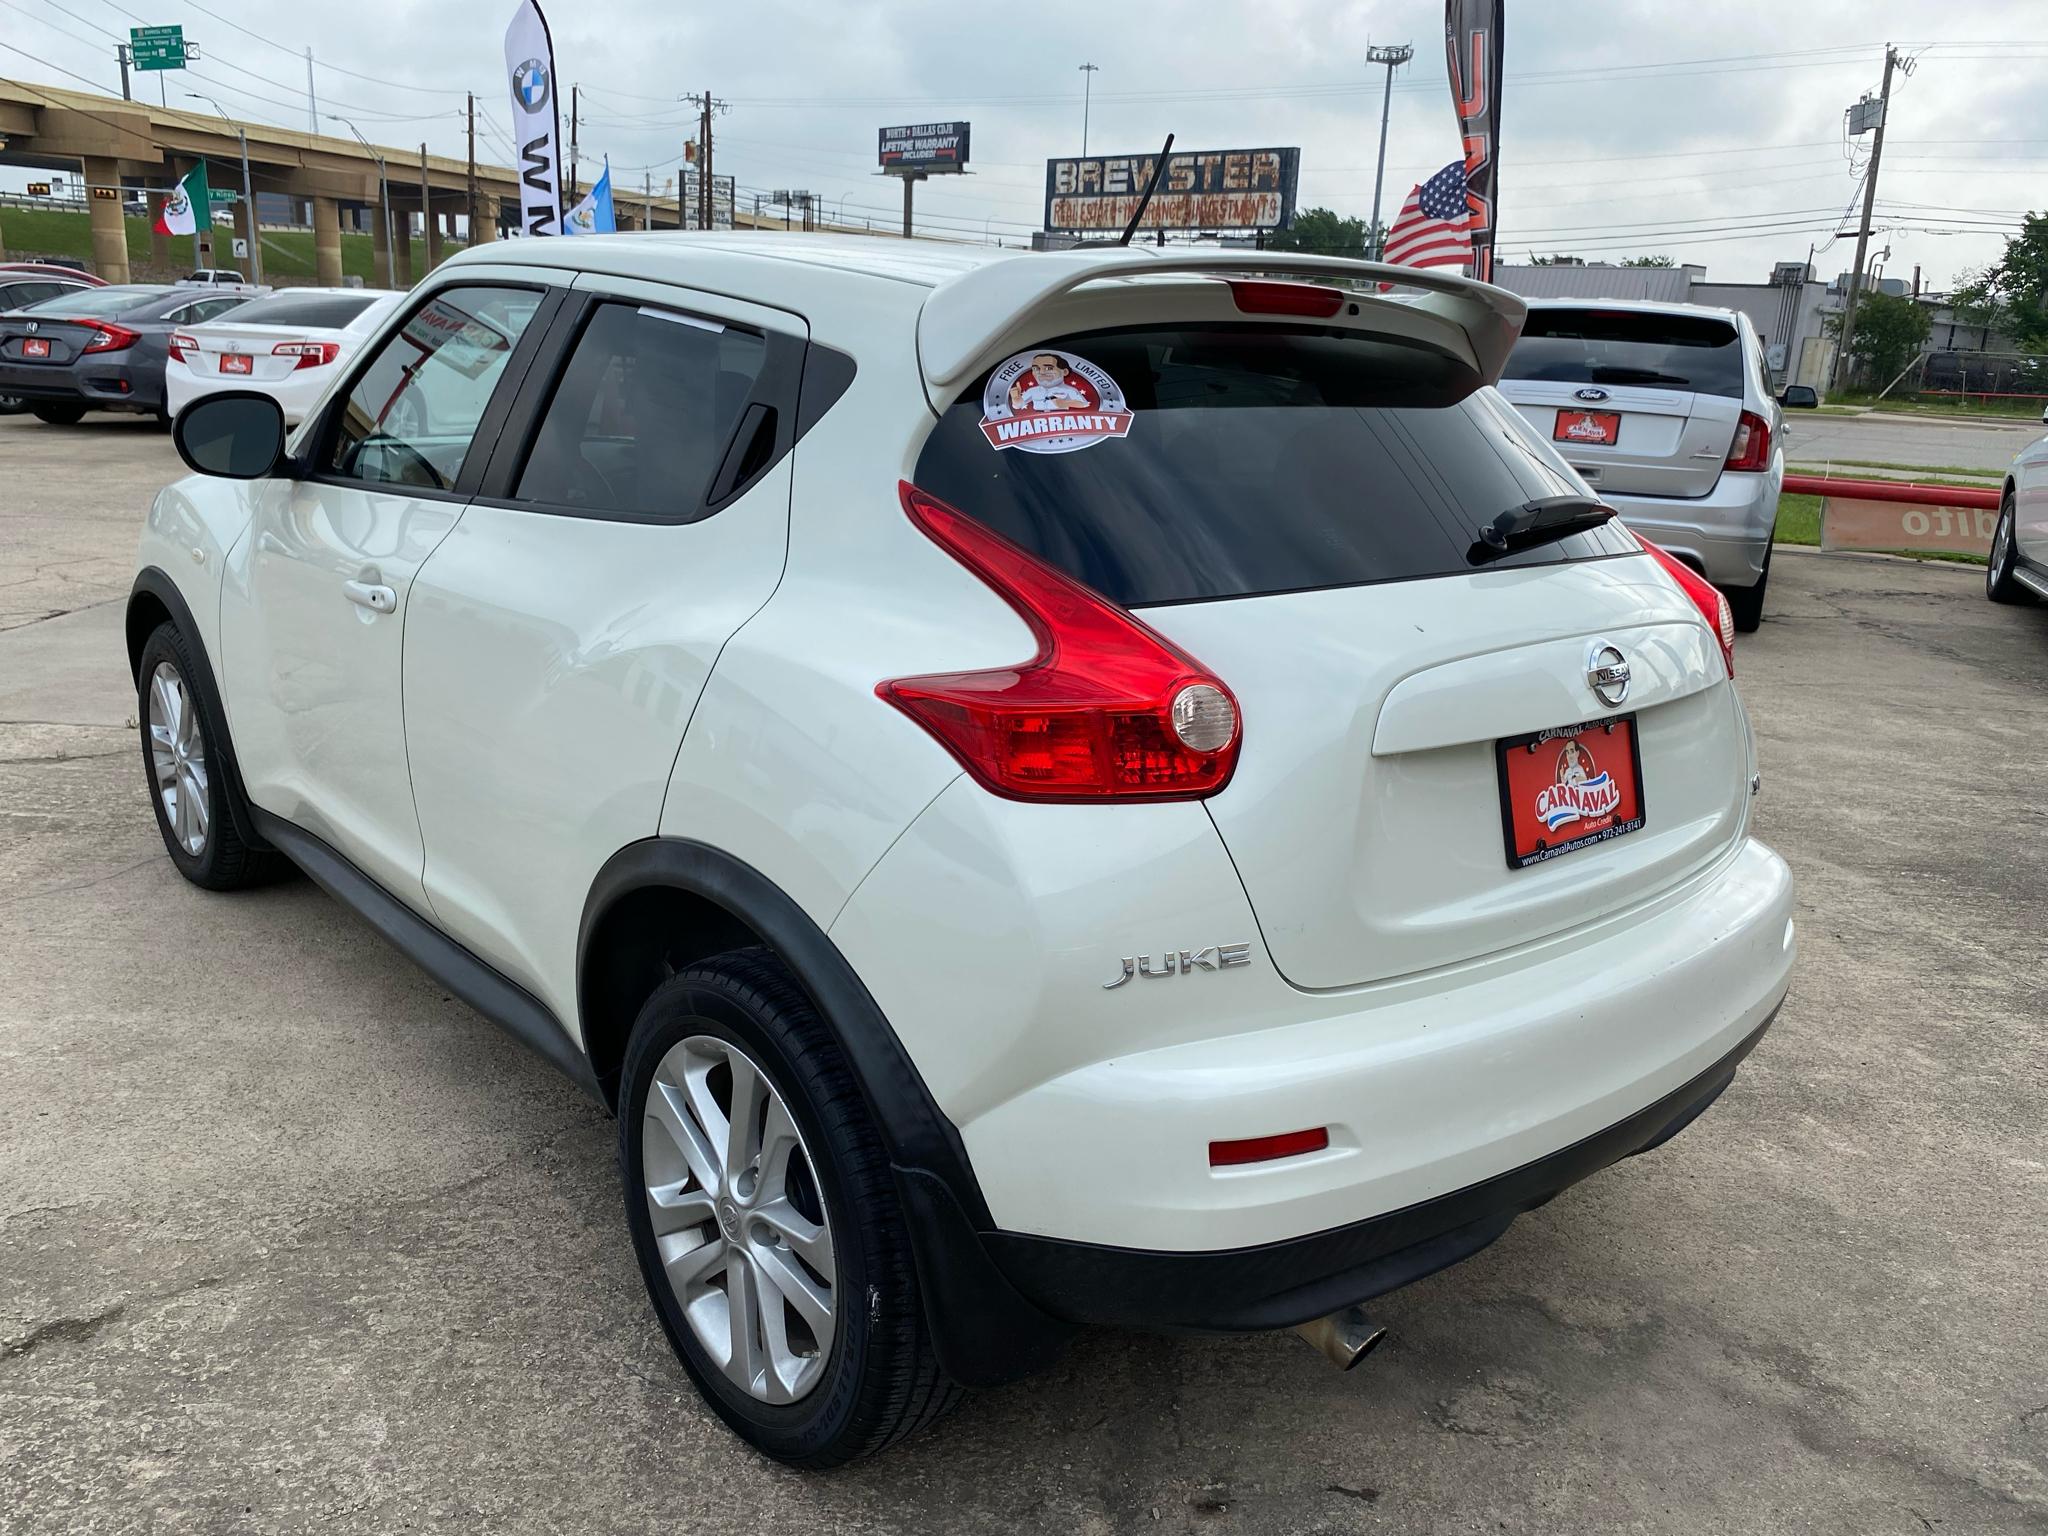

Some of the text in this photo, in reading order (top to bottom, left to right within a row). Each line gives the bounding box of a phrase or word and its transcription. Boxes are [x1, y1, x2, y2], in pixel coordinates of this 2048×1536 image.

[886, 122, 954, 139] NORTH DALLAS CDJR
[881, 136, 959, 153] LIFETIME WARRANTY
[902, 149, 937, 160] INCLUDED!
[1055, 153, 1281, 194] BREWSTER
[1053, 200, 1078, 223] REAL
[999, 360, 1024, 382] FREE
[1074, 361, 1111, 390] LIMITED
[1580, 390, 1602, 399] Ford
[996, 415, 1118, 441] WARRANTY
[1539, 724, 1584, 740] CARNAVAL
[1536, 780, 1617, 818] CARNAVAL
[1584, 815, 1612, 831] Auto Credit
[1521, 819, 1641, 867] www.CarnavalAutos.com 972-241-8141
[1102, 941, 1251, 990] JUKE
